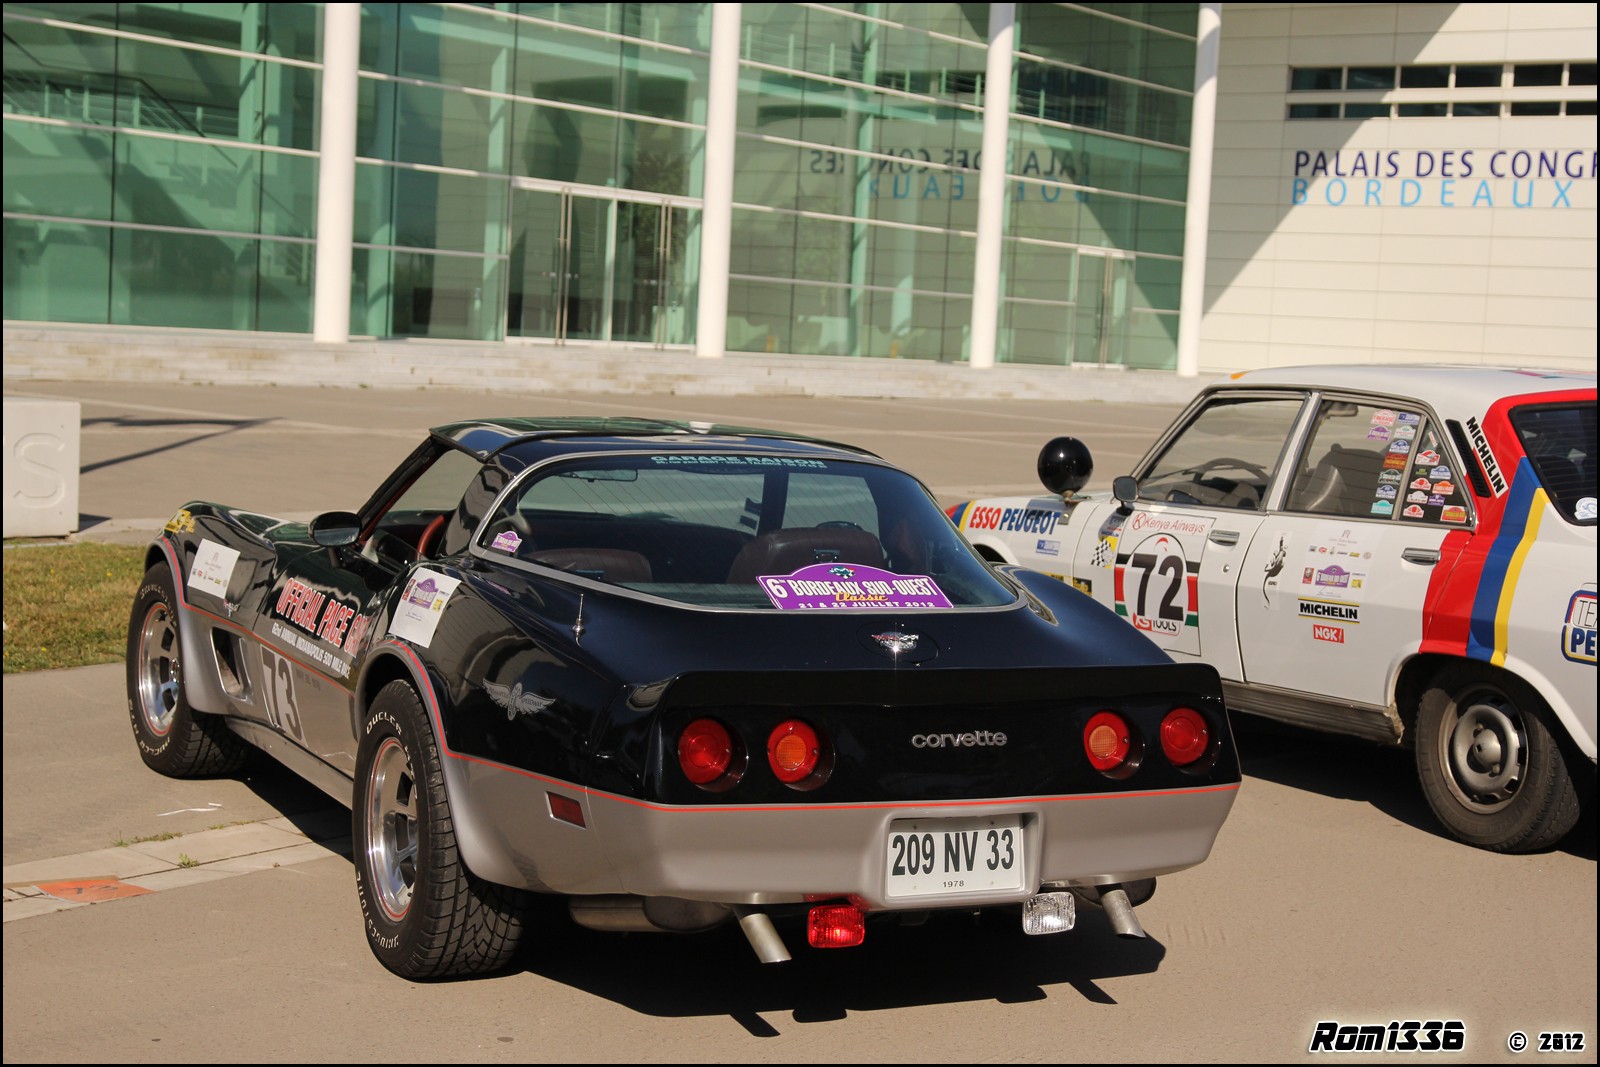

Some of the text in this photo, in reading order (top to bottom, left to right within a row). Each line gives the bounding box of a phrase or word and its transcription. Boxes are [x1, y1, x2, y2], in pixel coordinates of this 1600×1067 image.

[1294, 151, 1400, 178] PALAIS
[1415, 151, 1474, 178] DES
[1292, 178, 1574, 208] BORDEAUX
[744, 456, 825, 466] RAISON
[1466, 416, 1505, 493] MICHELIN
[969, 506, 1061, 535] ESSO PEUGEOT
[1144, 517, 1205, 535] Kenya Airways
[786, 579, 864, 596] BORDEAUX
[862, 577, 938, 596] SUD-OUEST
[835, 592, 890, 602] Classic
[1131, 552, 1184, 622] 72
[276, 577, 326, 633] OFFICIAL
[316, 599, 355, 648] PACE
[1300, 603, 1358, 619] MICHELIN
[1577, 600, 1597, 628] TE
[1314, 627, 1338, 641] NGK
[262, 646, 302, 741] 73
[911, 730, 1008, 748] corvette
[892, 829, 1015, 876] 209 NV 33
[942, 880, 965, 888] 1978
